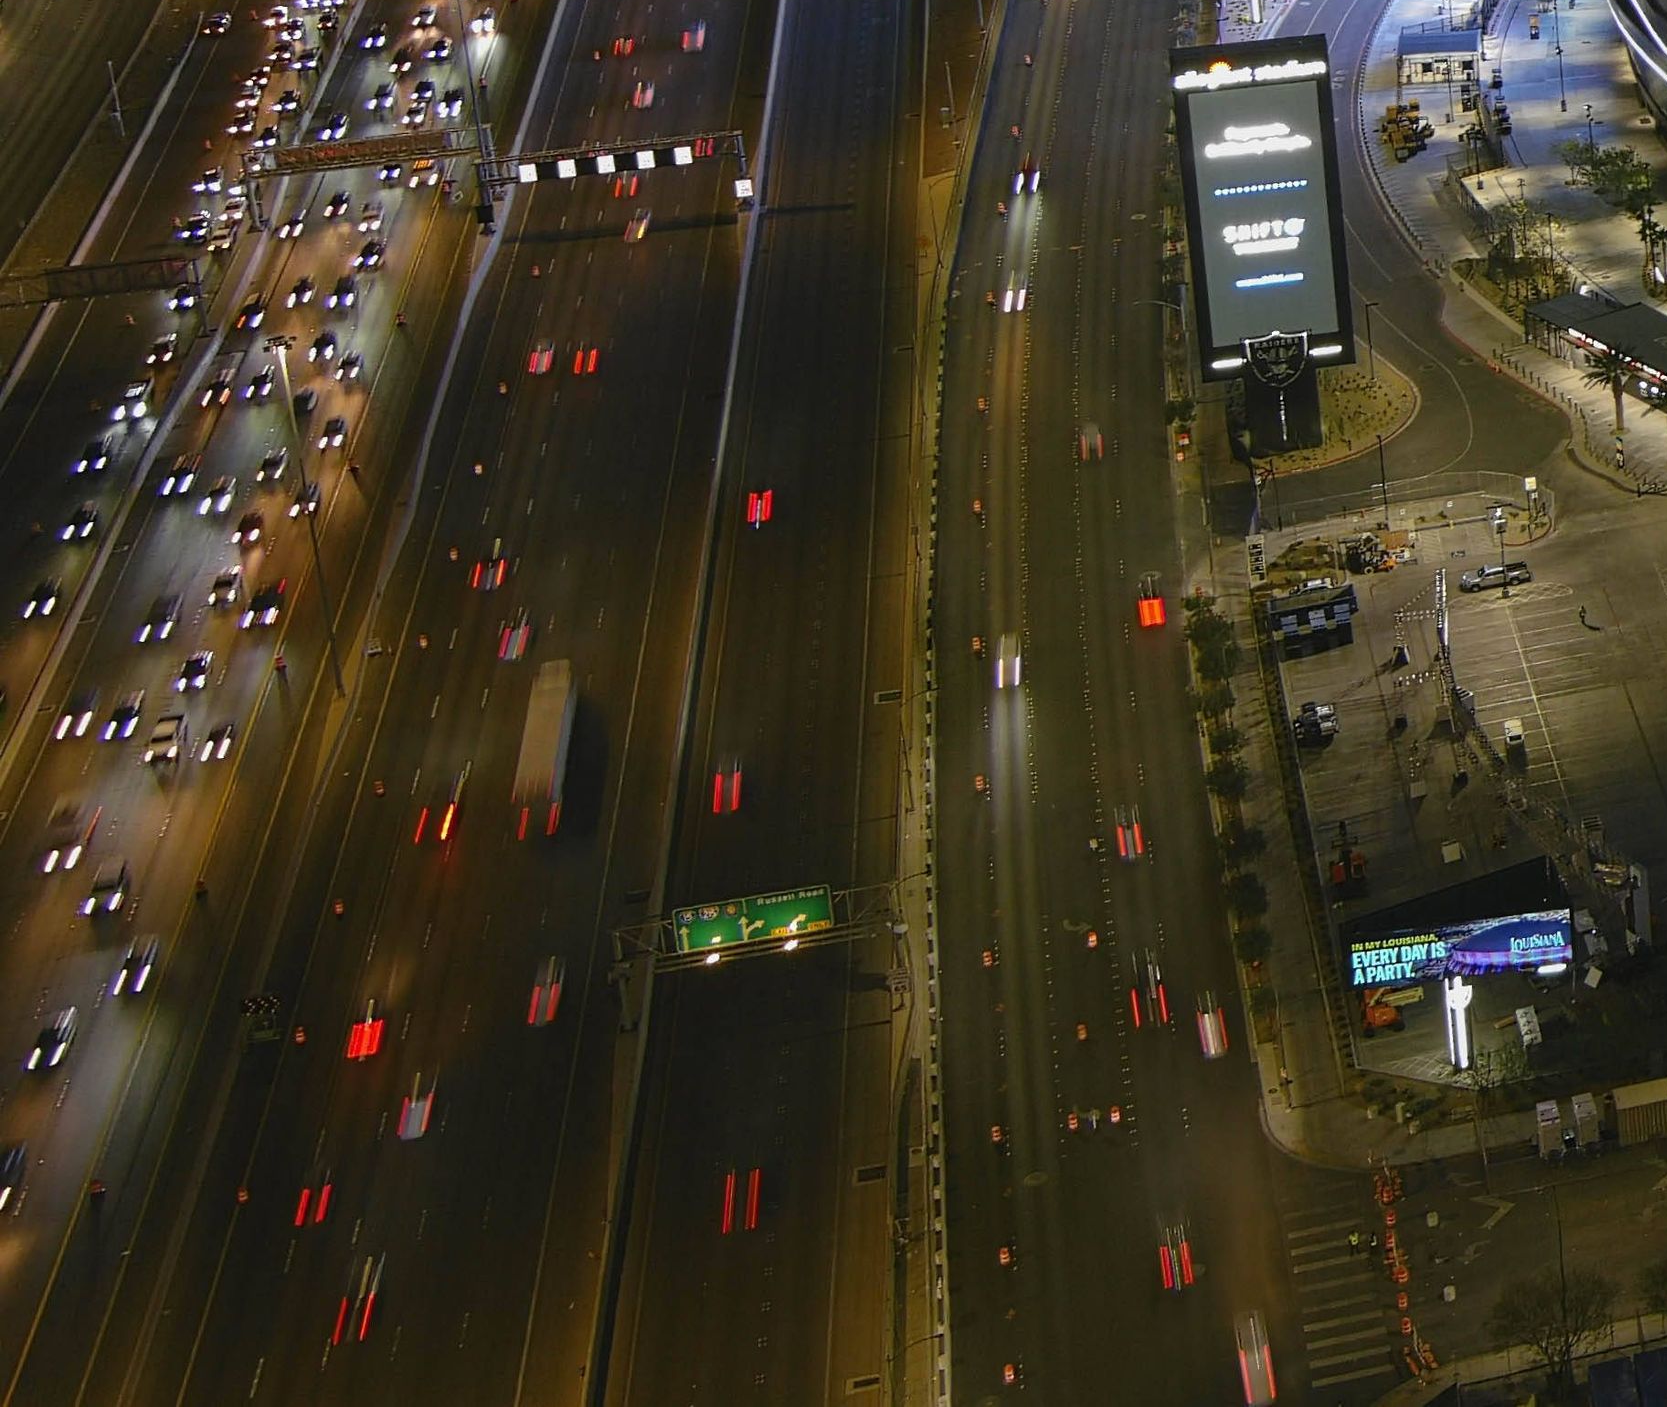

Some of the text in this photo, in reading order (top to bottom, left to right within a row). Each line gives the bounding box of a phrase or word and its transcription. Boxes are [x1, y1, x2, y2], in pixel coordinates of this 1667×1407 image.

[757, 893, 796, 906] Russell
[1351, 933, 1439, 952] IN MY LOUISIANA,
[1352, 940, 1446, 969] EVERY DAY IS
[1353, 962, 1416, 985] A PARTY.
